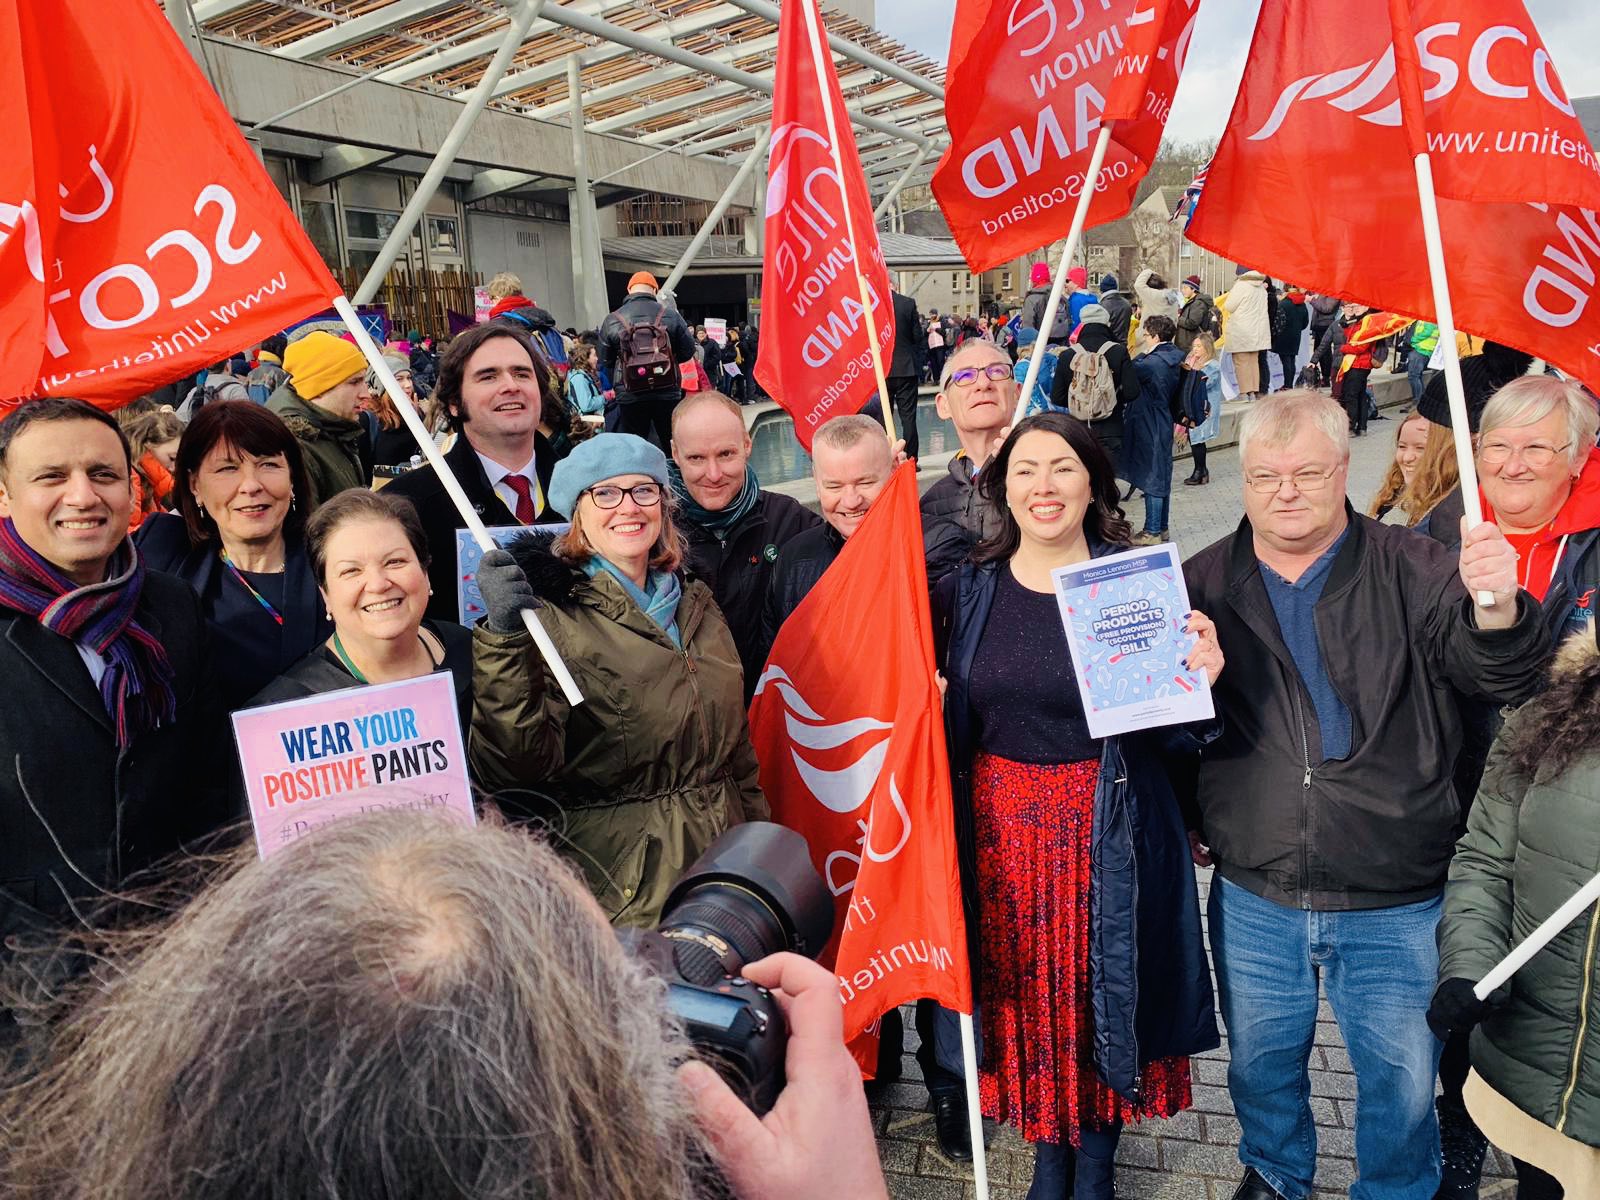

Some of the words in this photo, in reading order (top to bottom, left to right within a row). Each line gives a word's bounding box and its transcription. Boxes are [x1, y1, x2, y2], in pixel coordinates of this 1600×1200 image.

[1083, 568, 1107, 579] Monica
[1107, 563, 1132, 574] Lennon
[1132, 558, 1148, 568] MSP
[1101, 599, 1150, 619] PERIOD
[1093, 608, 1164, 632] PRODUCTS
[1097, 630, 1120, 641] (FREE
[1120, 620, 1166, 634] PROVISION)
[1109, 630, 1157, 646] (SCOTLAND)
[1120, 640, 1151, 655] BILL
[280, 721, 353, 764] WEAR
[354, 707, 419, 749] YOUR
[263, 756, 371, 808] POSITIVE
[371, 739, 449, 785] PANTS
